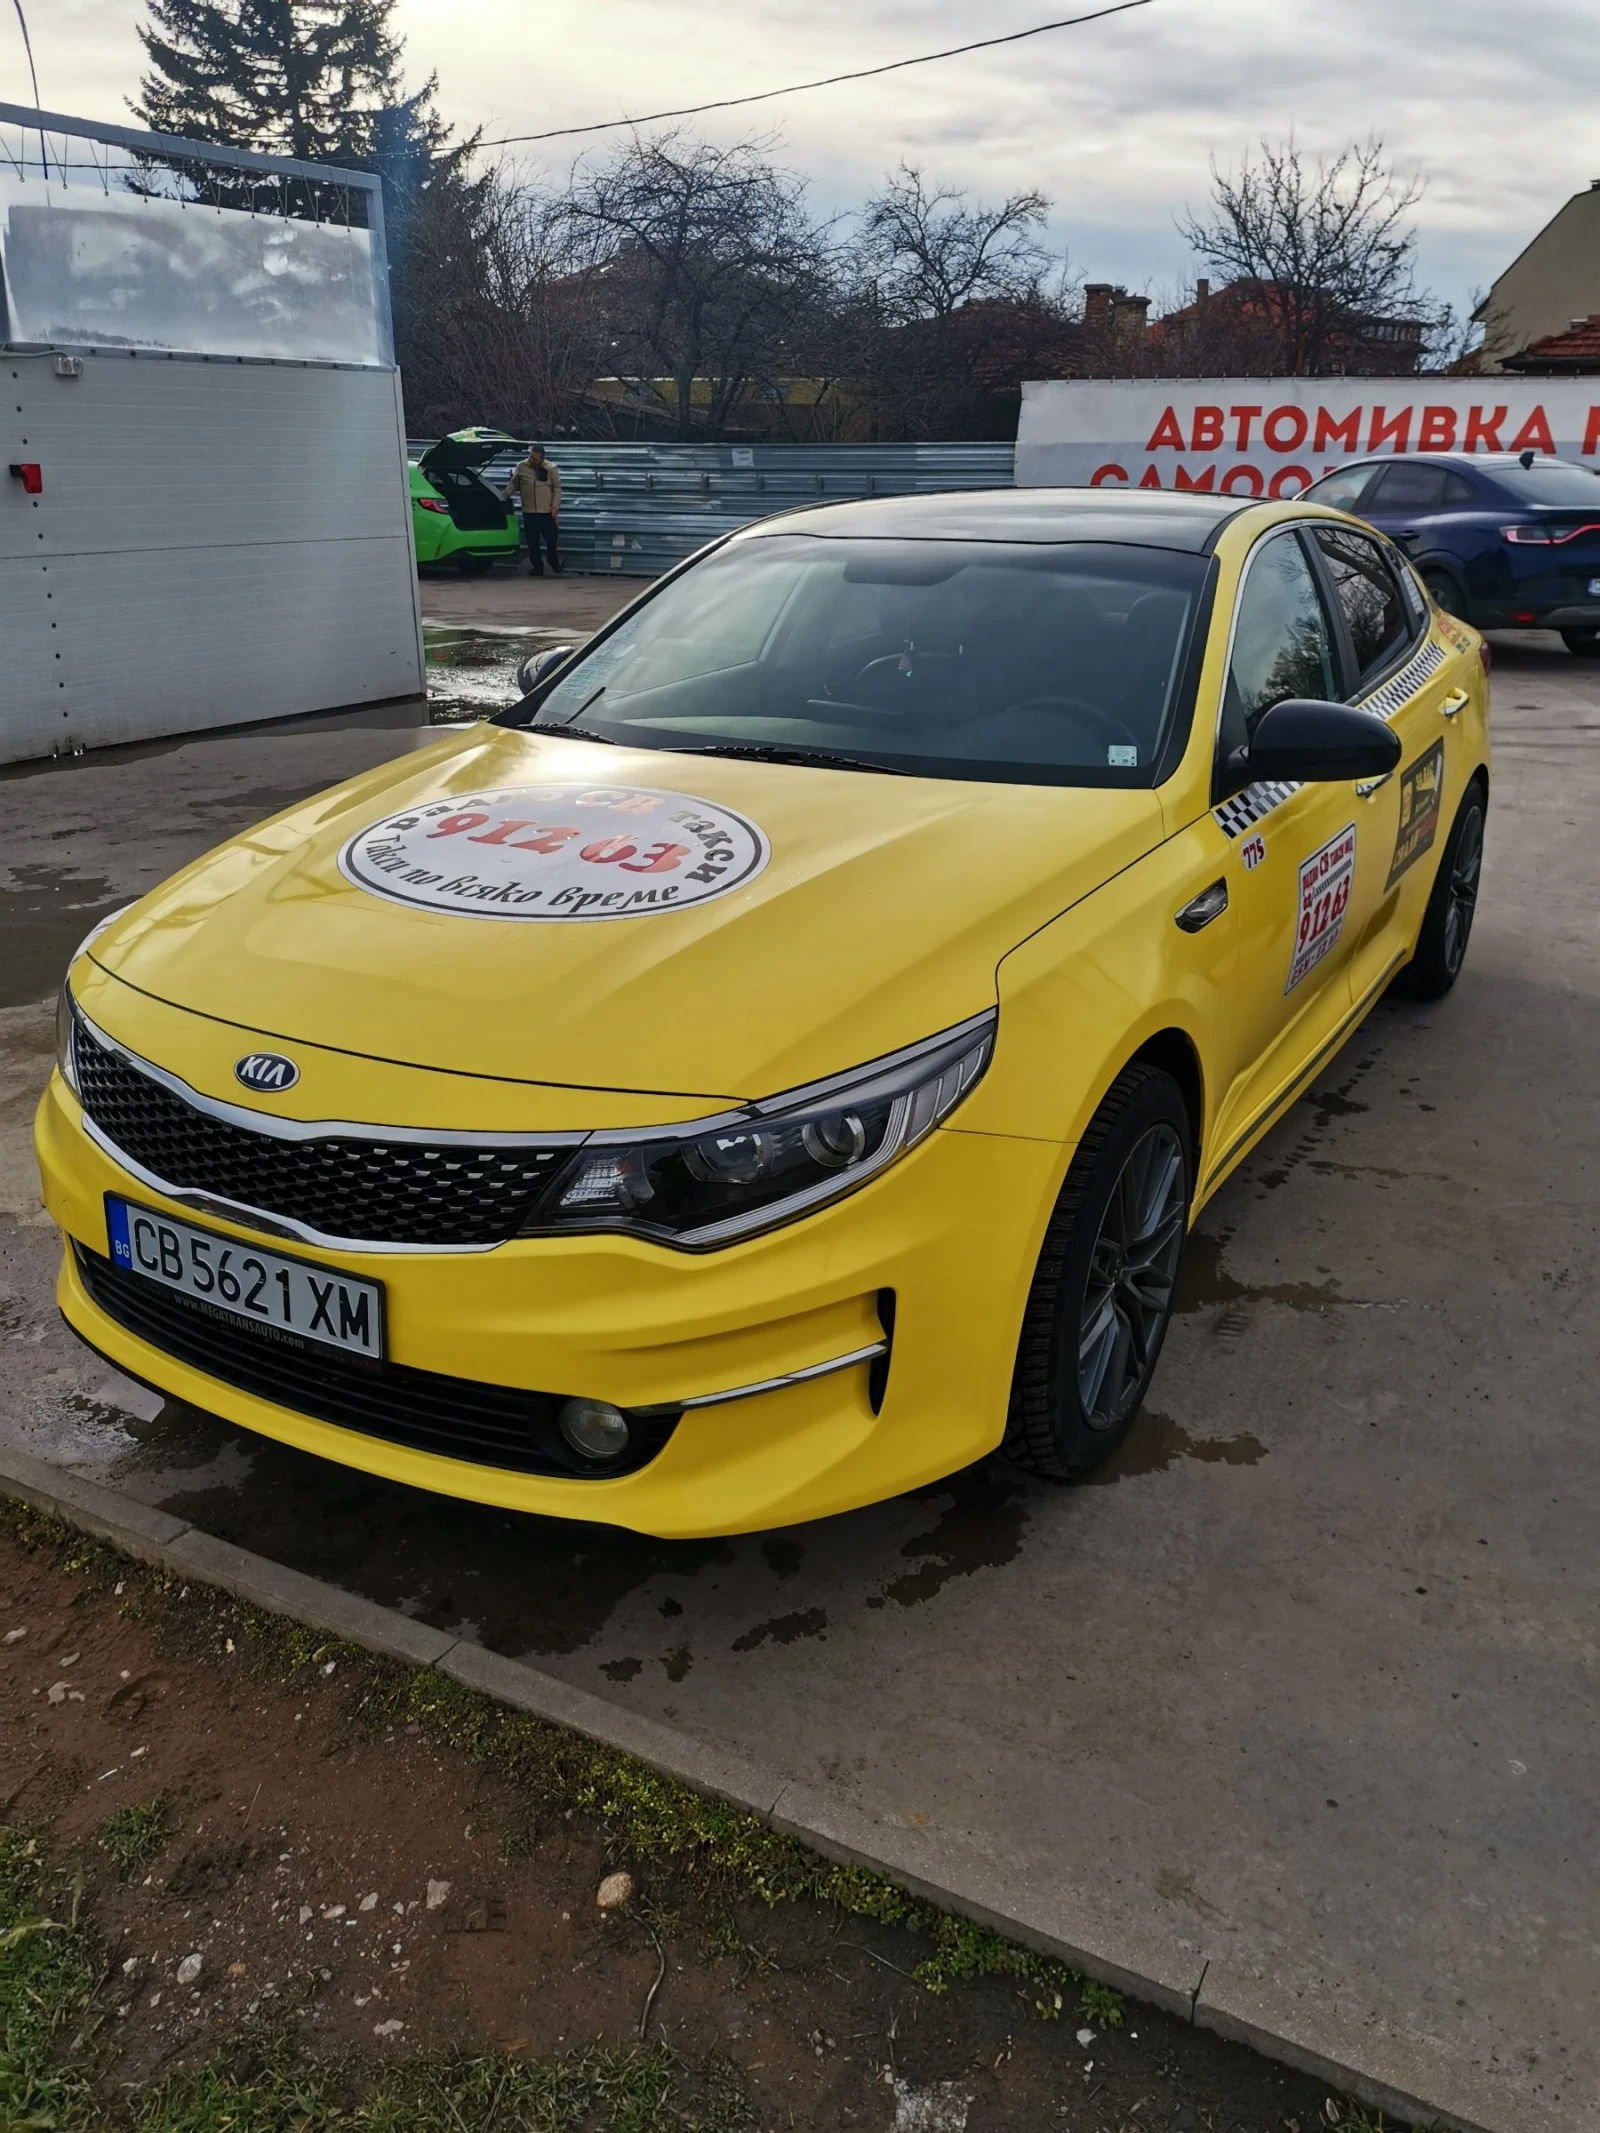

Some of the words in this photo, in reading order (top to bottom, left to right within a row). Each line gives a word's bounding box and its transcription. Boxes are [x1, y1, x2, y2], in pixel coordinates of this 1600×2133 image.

[1145, 405, 1557, 455] АВТОМИВКА
[366, 834, 410, 873] Такси
[398, 868, 445, 885] по
[436, 875, 543, 903] всяко
[547, 886, 680, 913] време
[1243, 837, 1264, 869] 775
[240, 1056, 286, 1086] KIA
[115, 1240, 130, 1258] BG
[174, 1294, 305, 1350] www.MEGATRANSAUTO.com
